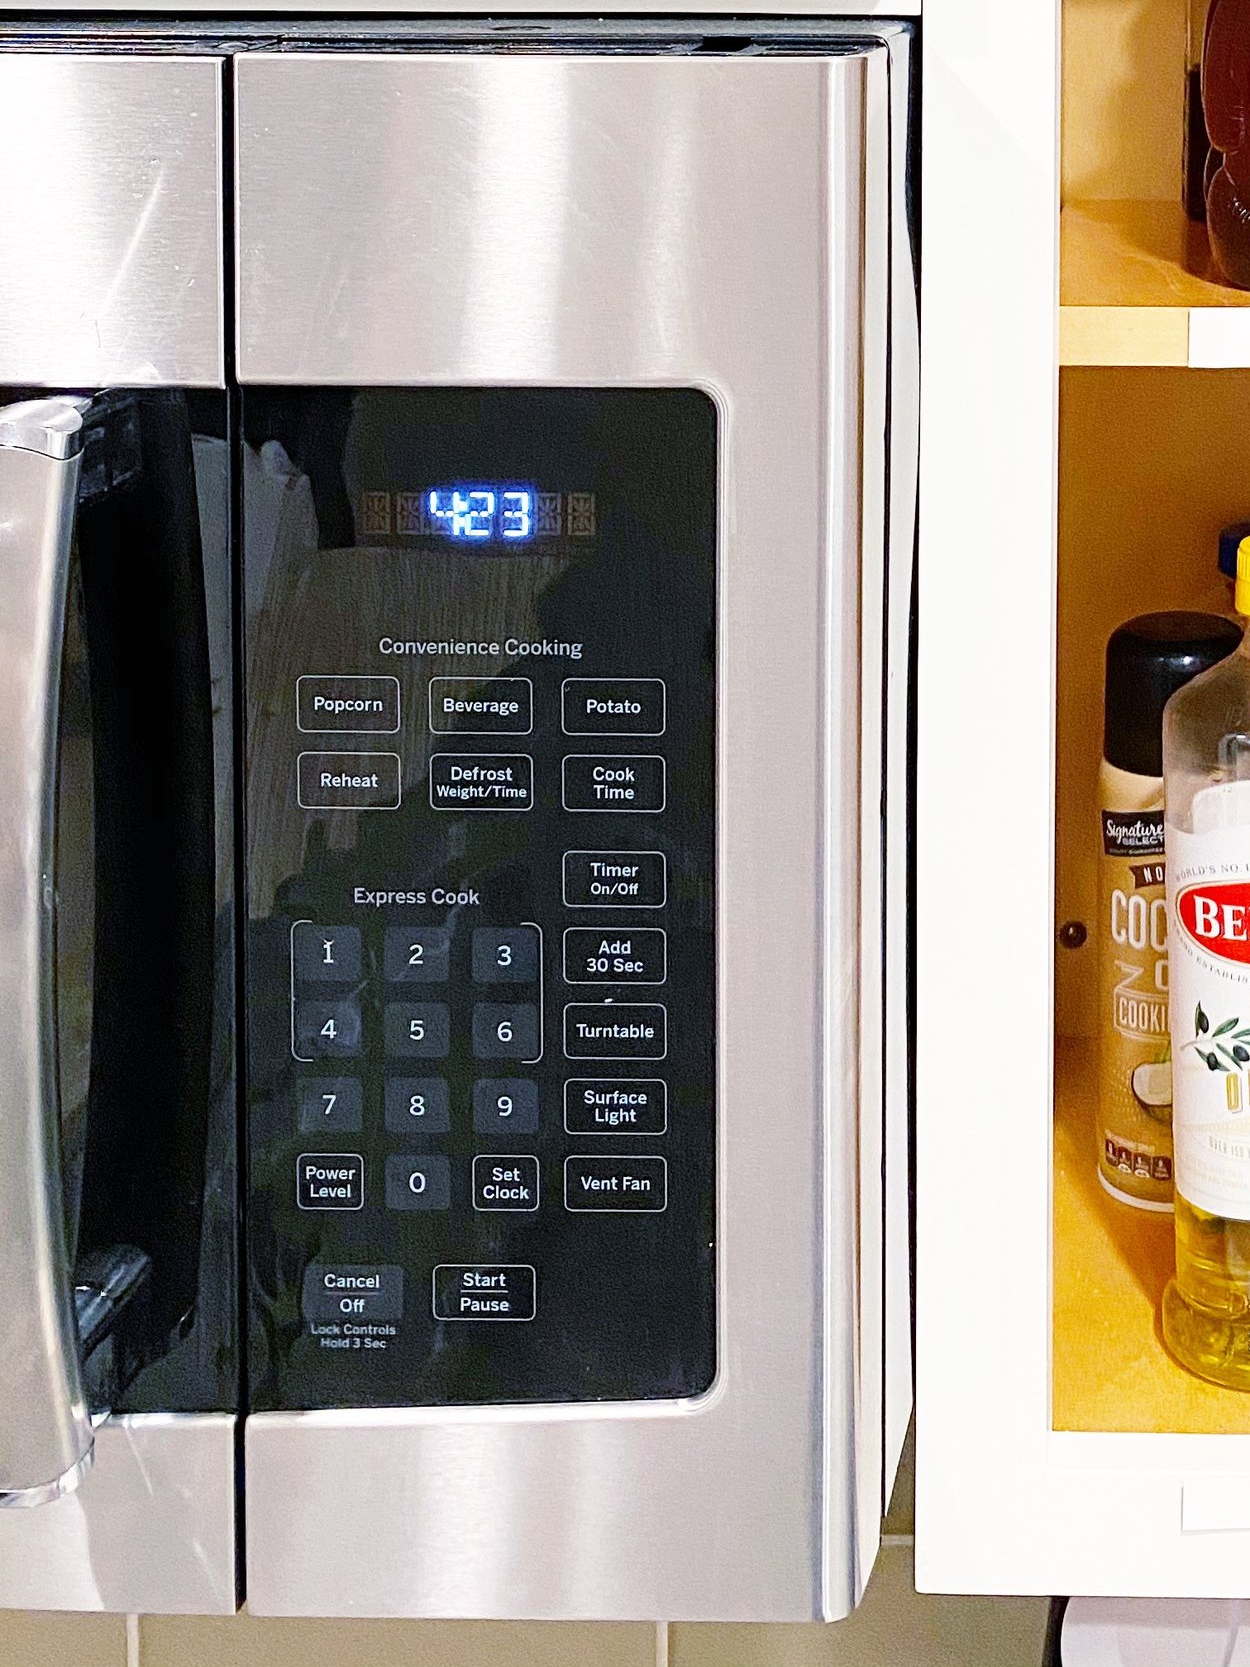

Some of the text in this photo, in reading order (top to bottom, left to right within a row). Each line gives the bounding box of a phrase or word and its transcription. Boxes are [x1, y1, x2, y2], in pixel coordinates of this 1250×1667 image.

[429, 491, 529, 536] 4:23
[379, 637, 583, 659] Convenience Cooking
[313, 696, 383, 715] Popcorn
[443, 698, 519, 716] Beverage
[586, 699, 641, 714] Potato
[320, 773, 378, 788] Reheat
[450, 766, 513, 781] Defrost
[592, 766, 635, 782] Cook
[436, 785, 527, 801] Weight/Time
[593, 785, 635, 800] Time
[1106, 819, 1165, 844] Signature
[590, 862, 639, 878] Timer
[590, 882, 639, 896] On/Off
[354, 887, 480, 908] Express Cook
[323, 944, 512, 966] 1 2 3
[599, 940, 631, 955] Add
[586, 958, 644, 973] 30 Sec
[320, 1020, 512, 1042] 4 5 6
[576, 1024, 654, 1038] Turntable
[584, 1090, 647, 1105] Surface
[322, 1096, 512, 1117] 7 8 9
[594, 1108, 636, 1125] Light
[305, 1166, 355, 1181] Power
[492, 1167, 521, 1182] Set
[409, 1173, 425, 1193] 0
[581, 1176, 651, 1191] Vent Fan
[309, 1184, 352, 1198] Level
[482, 1185, 529, 1200] Clock
[324, 1273, 380, 1288] Cancel
[462, 1272, 506, 1288] Start
[340, 1298, 365, 1313] Off
[460, 1298, 510, 1313] Pause
[311, 1323, 396, 1335] Lock Controls
[320, 1337, 387, 1348] Hold 3 Sec
